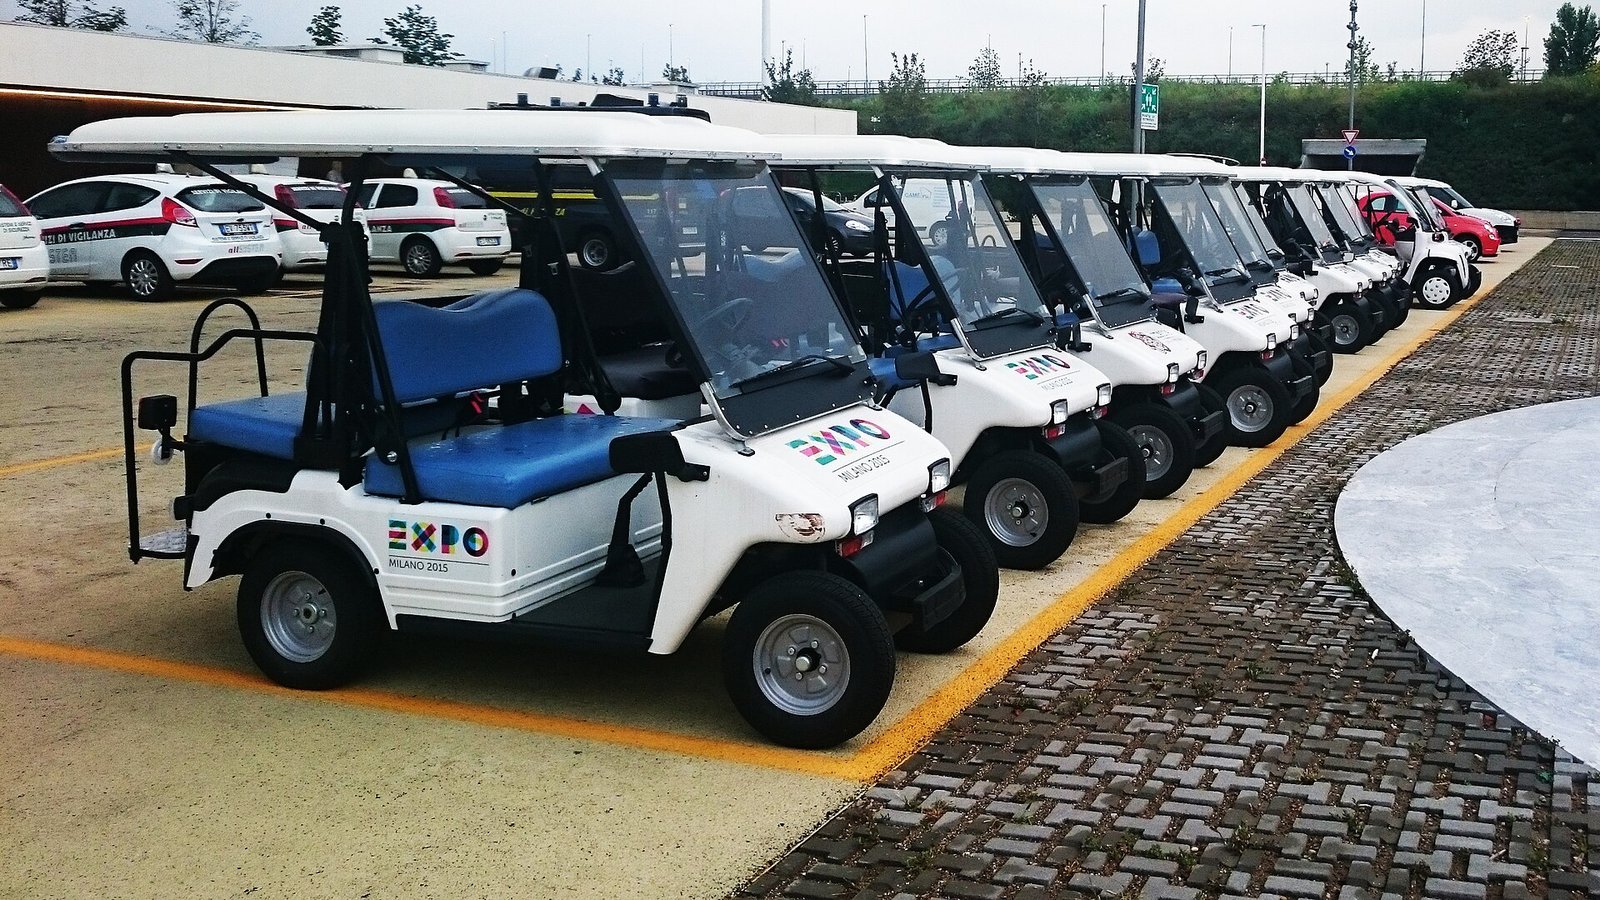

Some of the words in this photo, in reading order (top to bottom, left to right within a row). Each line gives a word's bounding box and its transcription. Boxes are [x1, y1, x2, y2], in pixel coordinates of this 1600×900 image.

[57, 233, 67, 243] DI
[68, 228, 117, 242] VIGILANZA
[1005, 354, 1071, 381] EXPO
[784, 418, 891, 466] EXPO
[838, 461, 873, 483] MILANO
[871, 454, 891, 470] 2015
[388, 518, 490, 558] EXPO
[388, 558, 425, 571] MILANO
[426, 562, 449, 573] 2015
